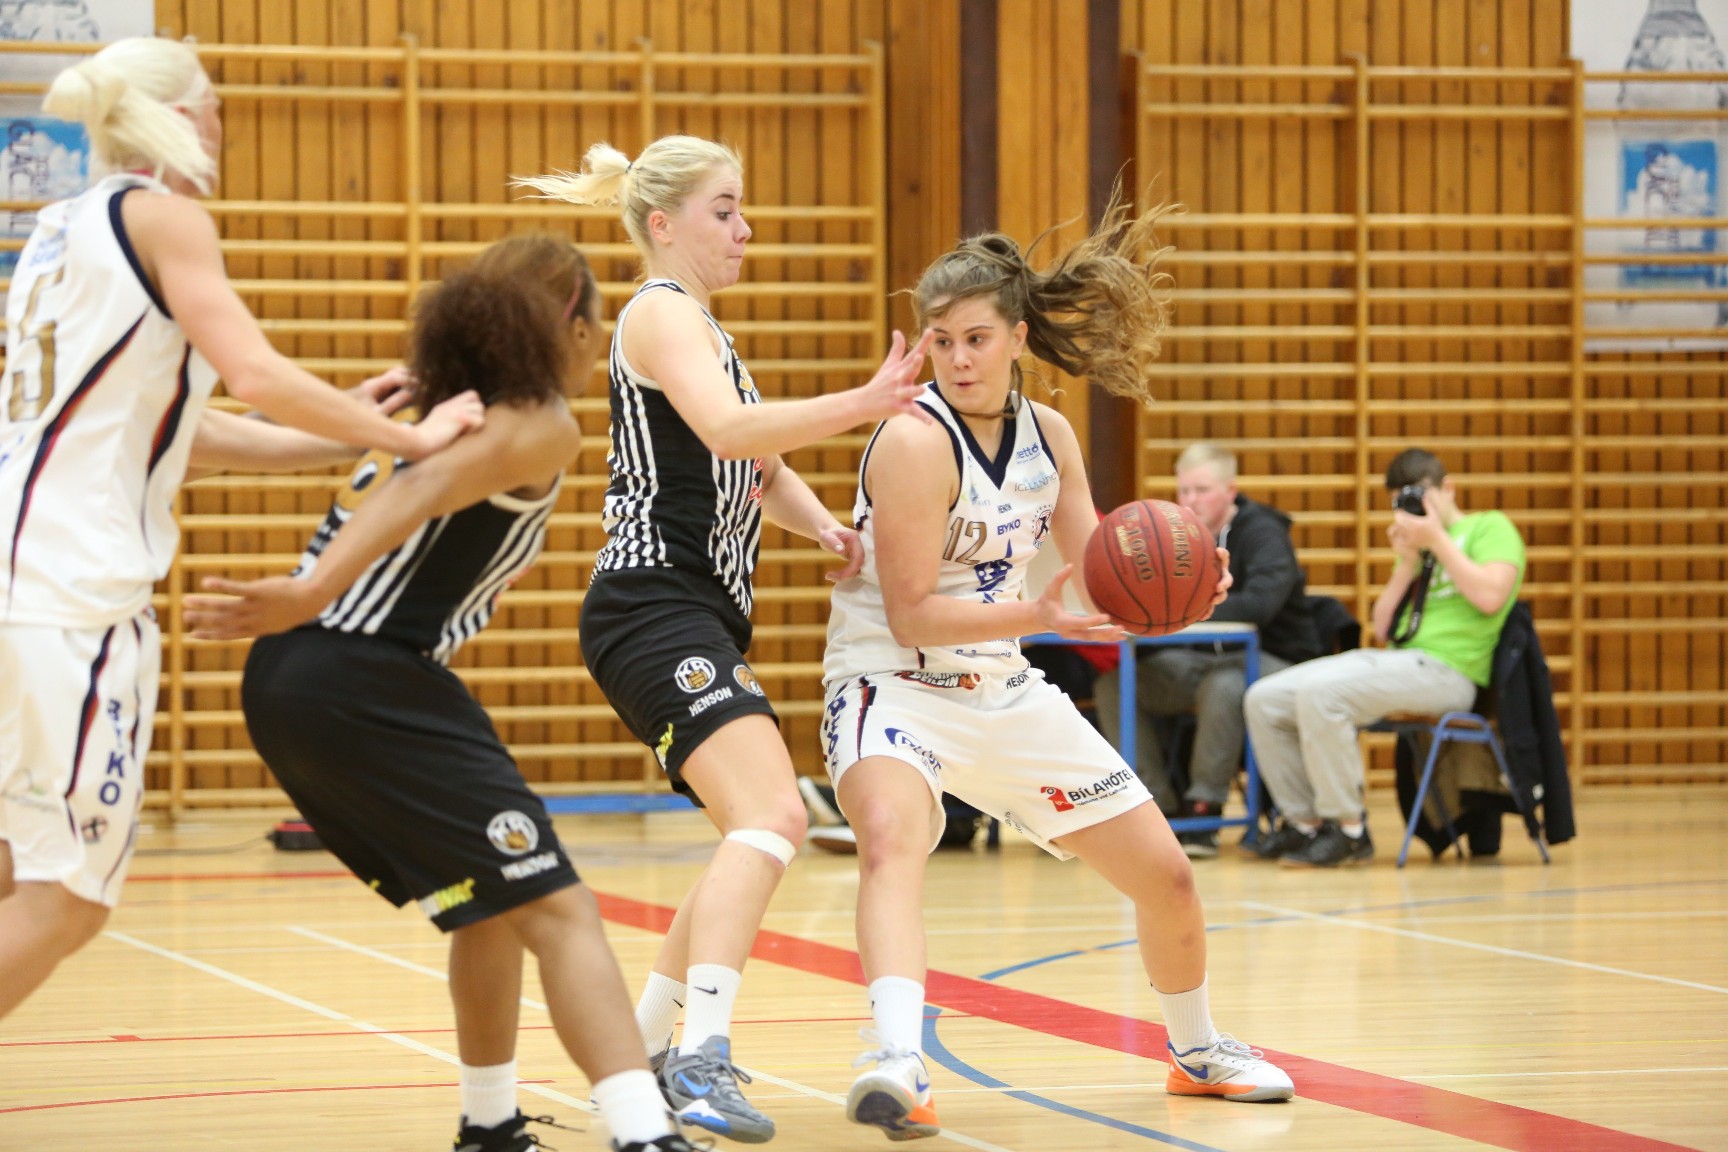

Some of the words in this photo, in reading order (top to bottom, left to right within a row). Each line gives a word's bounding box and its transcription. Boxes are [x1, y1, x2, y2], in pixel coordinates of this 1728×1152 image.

[8, 263, 65, 422] 5
[942, 516, 988, 566] 12
[997, 518, 1021, 536] BYKO
[688, 686, 733, 717] HENSON
[1067, 769, 1134, 802] BÍLAHÓTEL
